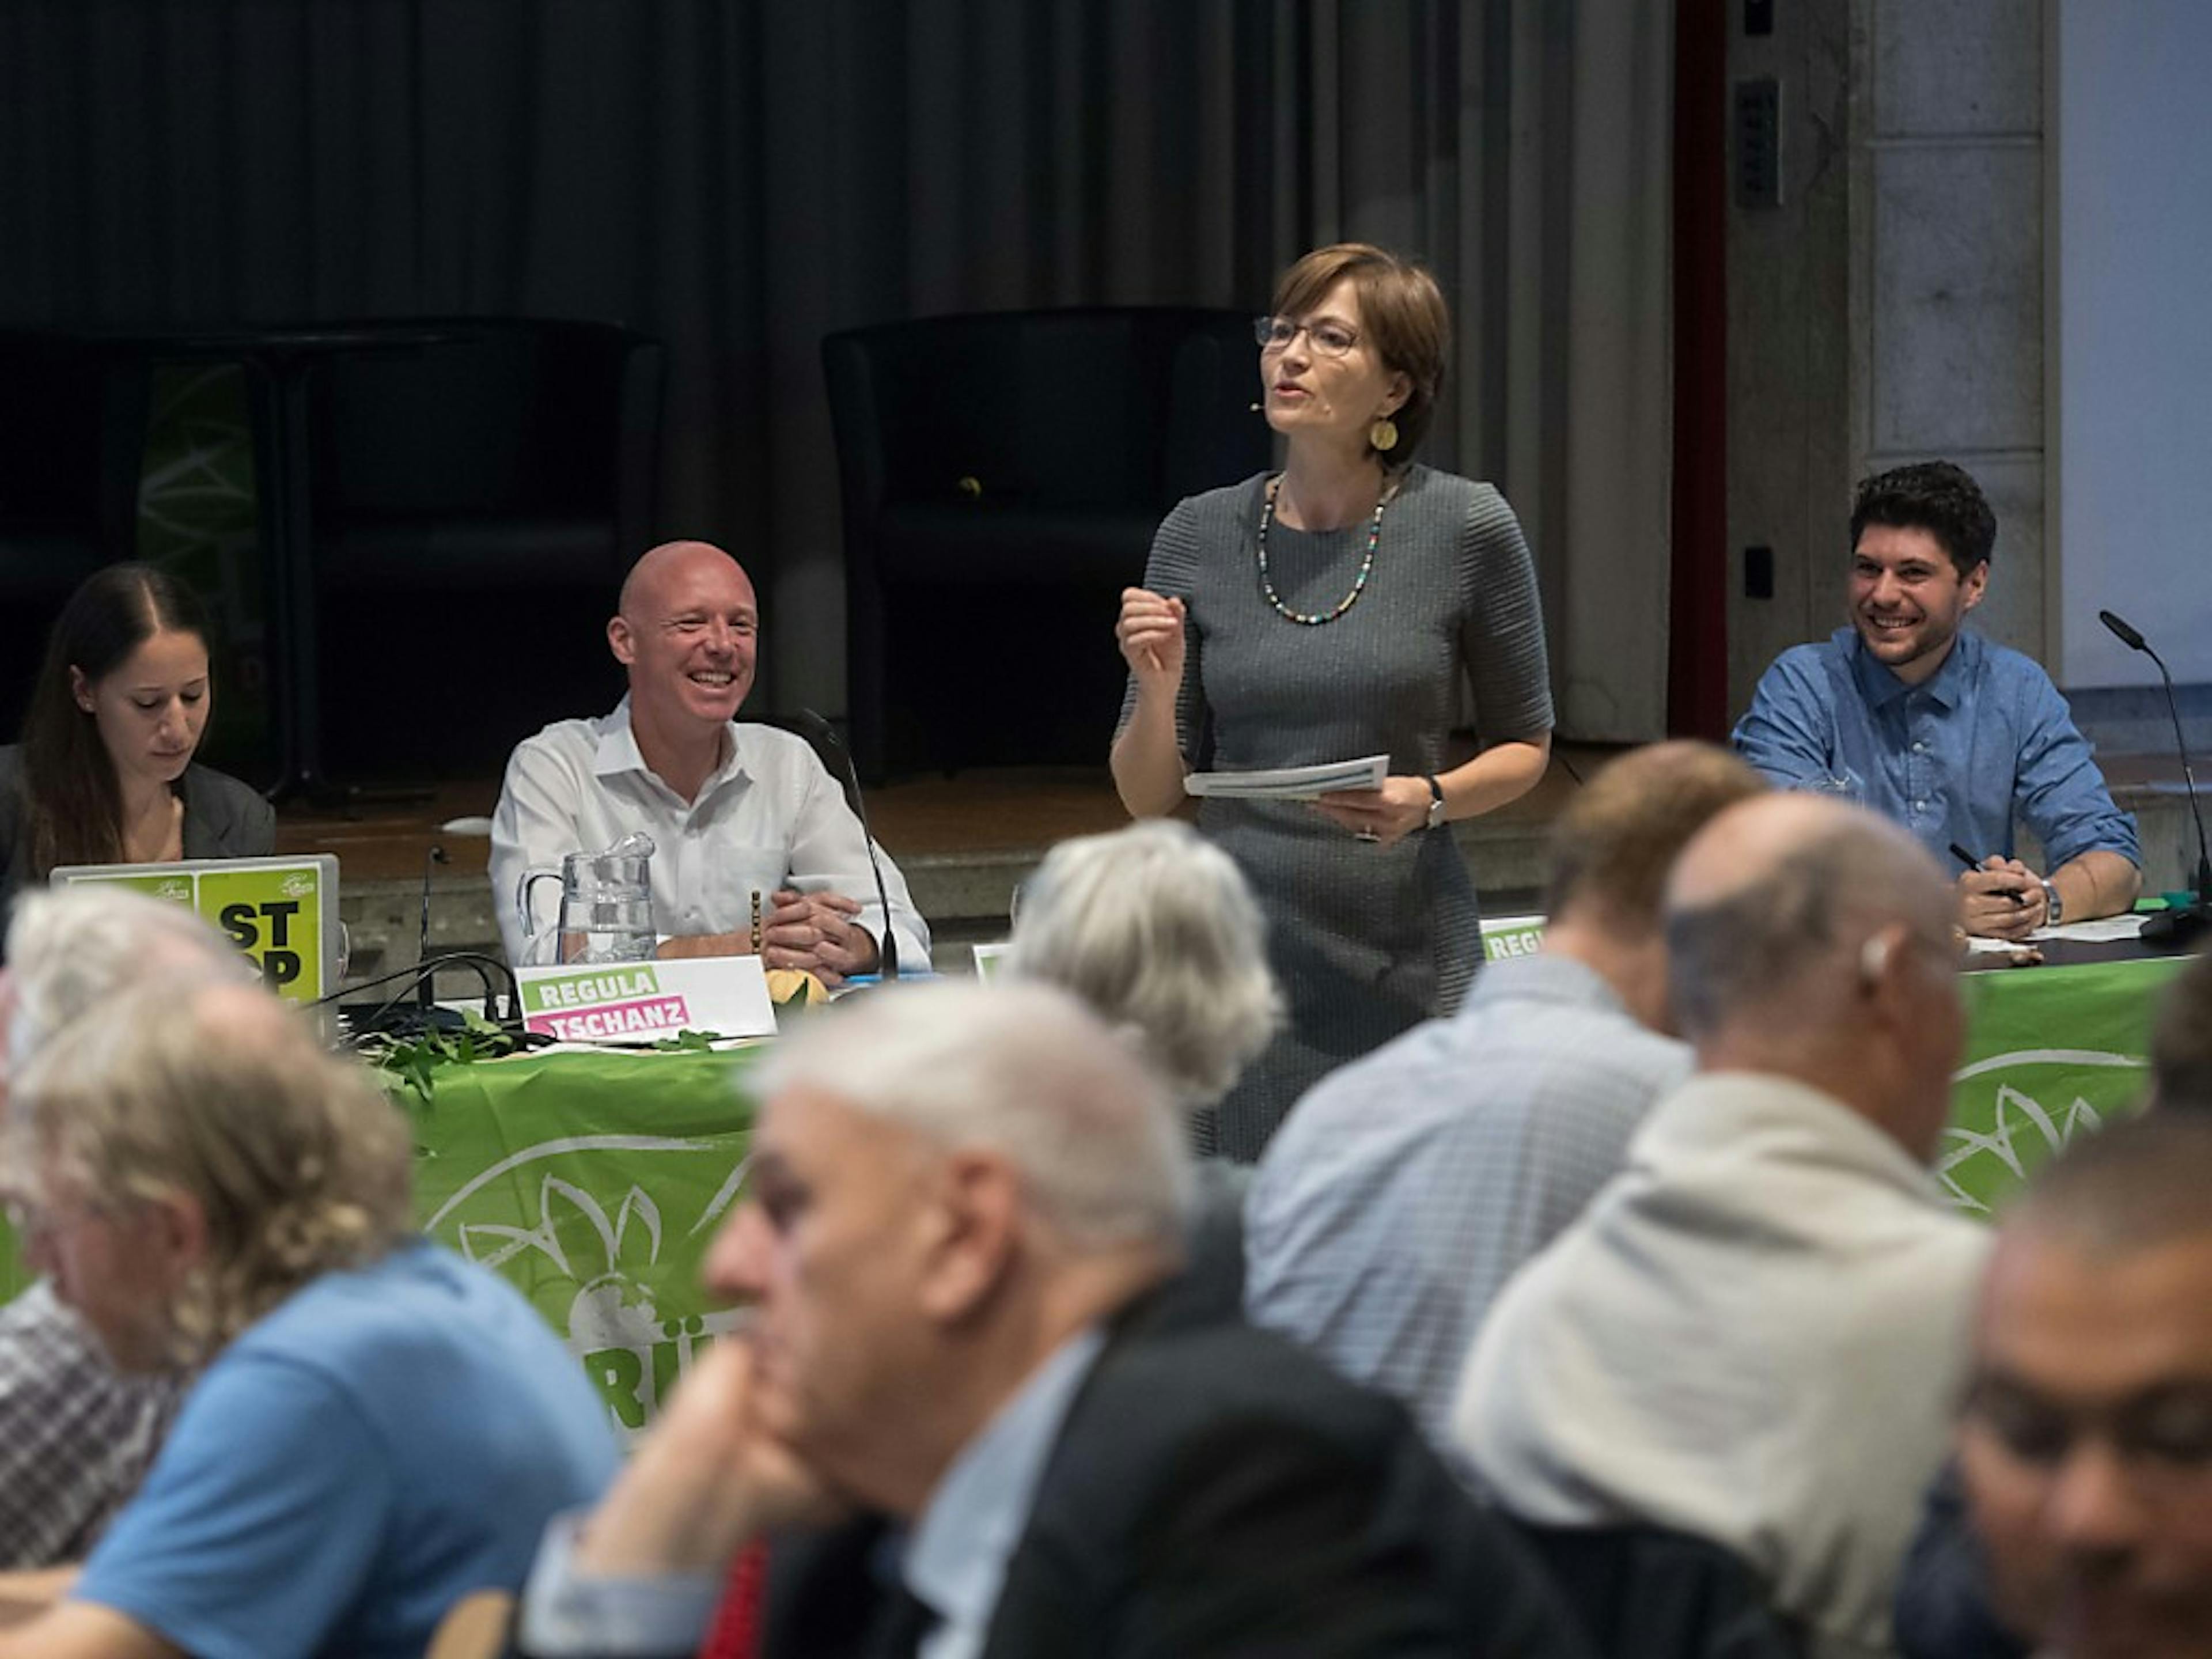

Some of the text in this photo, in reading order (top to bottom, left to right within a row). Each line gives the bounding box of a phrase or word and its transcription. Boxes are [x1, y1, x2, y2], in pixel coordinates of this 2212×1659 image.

[220, 901, 298, 948] ST
[242, 950, 301, 995] P
[539, 972, 654, 1007] REGULA
[550, 1003, 684, 1038] TSCHANZ
